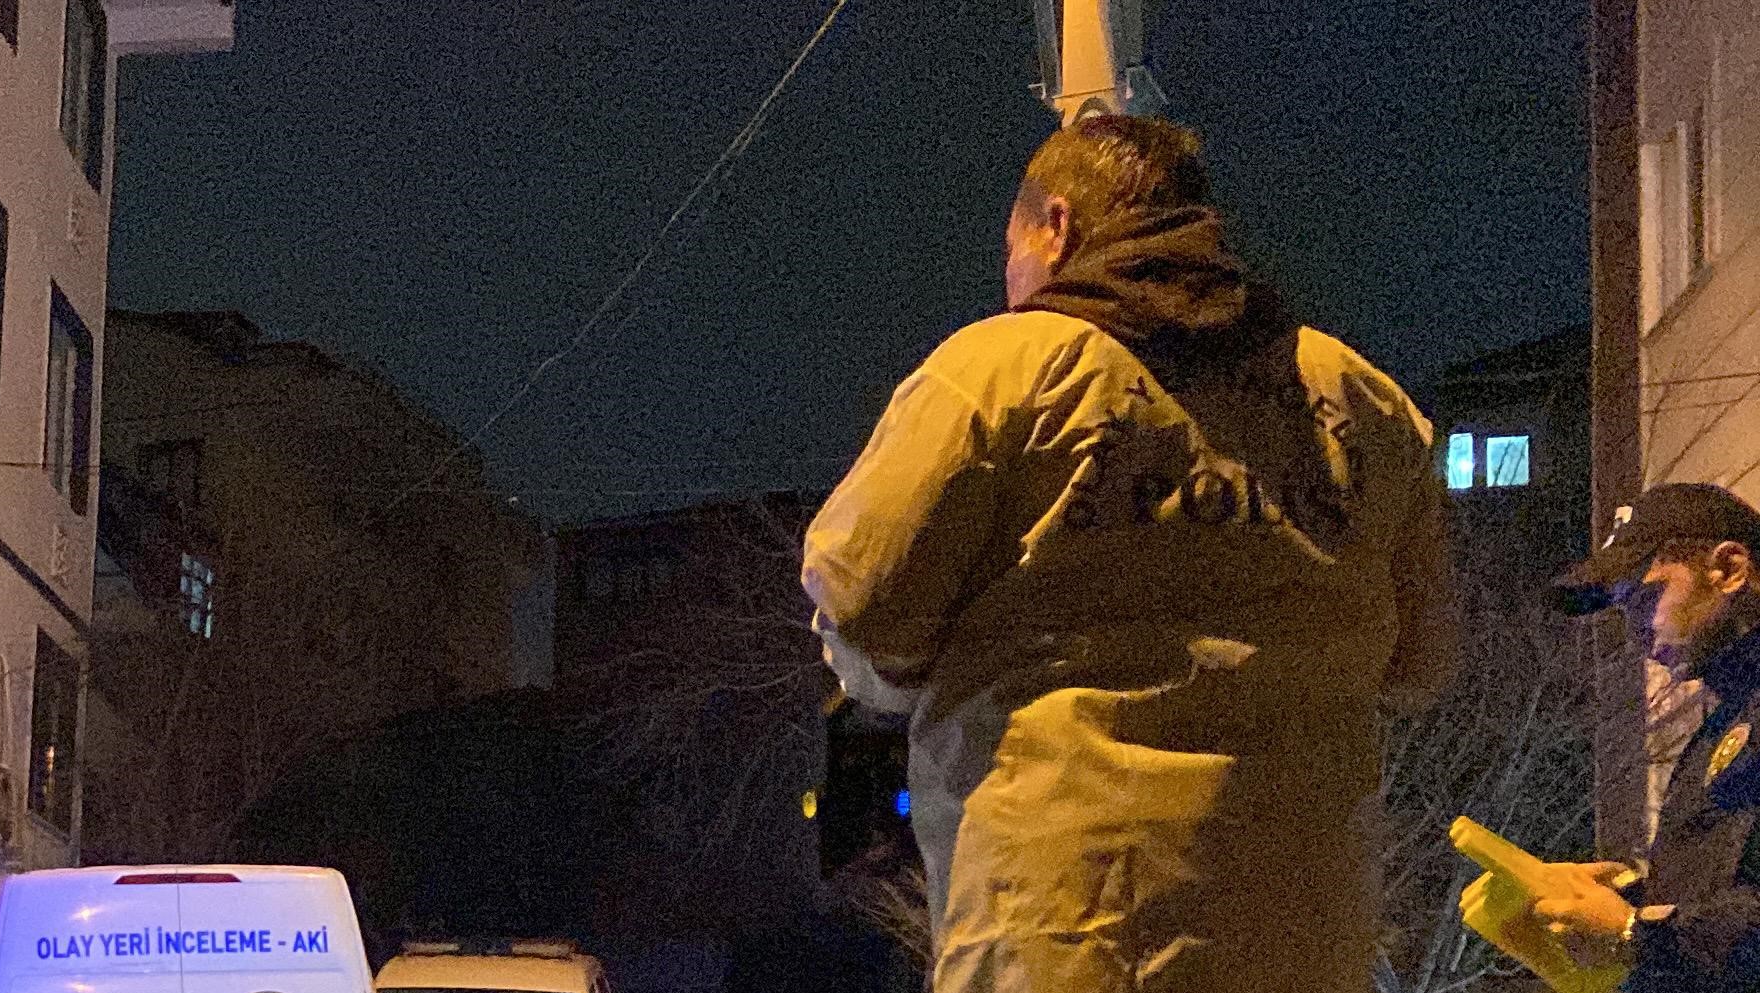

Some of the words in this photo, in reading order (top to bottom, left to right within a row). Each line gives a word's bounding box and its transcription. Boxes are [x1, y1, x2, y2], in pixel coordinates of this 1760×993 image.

[36, 934, 94, 960] OLAY
[99, 926, 151, 957] YERİ
[156, 925, 272, 955] İNCELEME
[292, 924, 329, 953] AKİ
